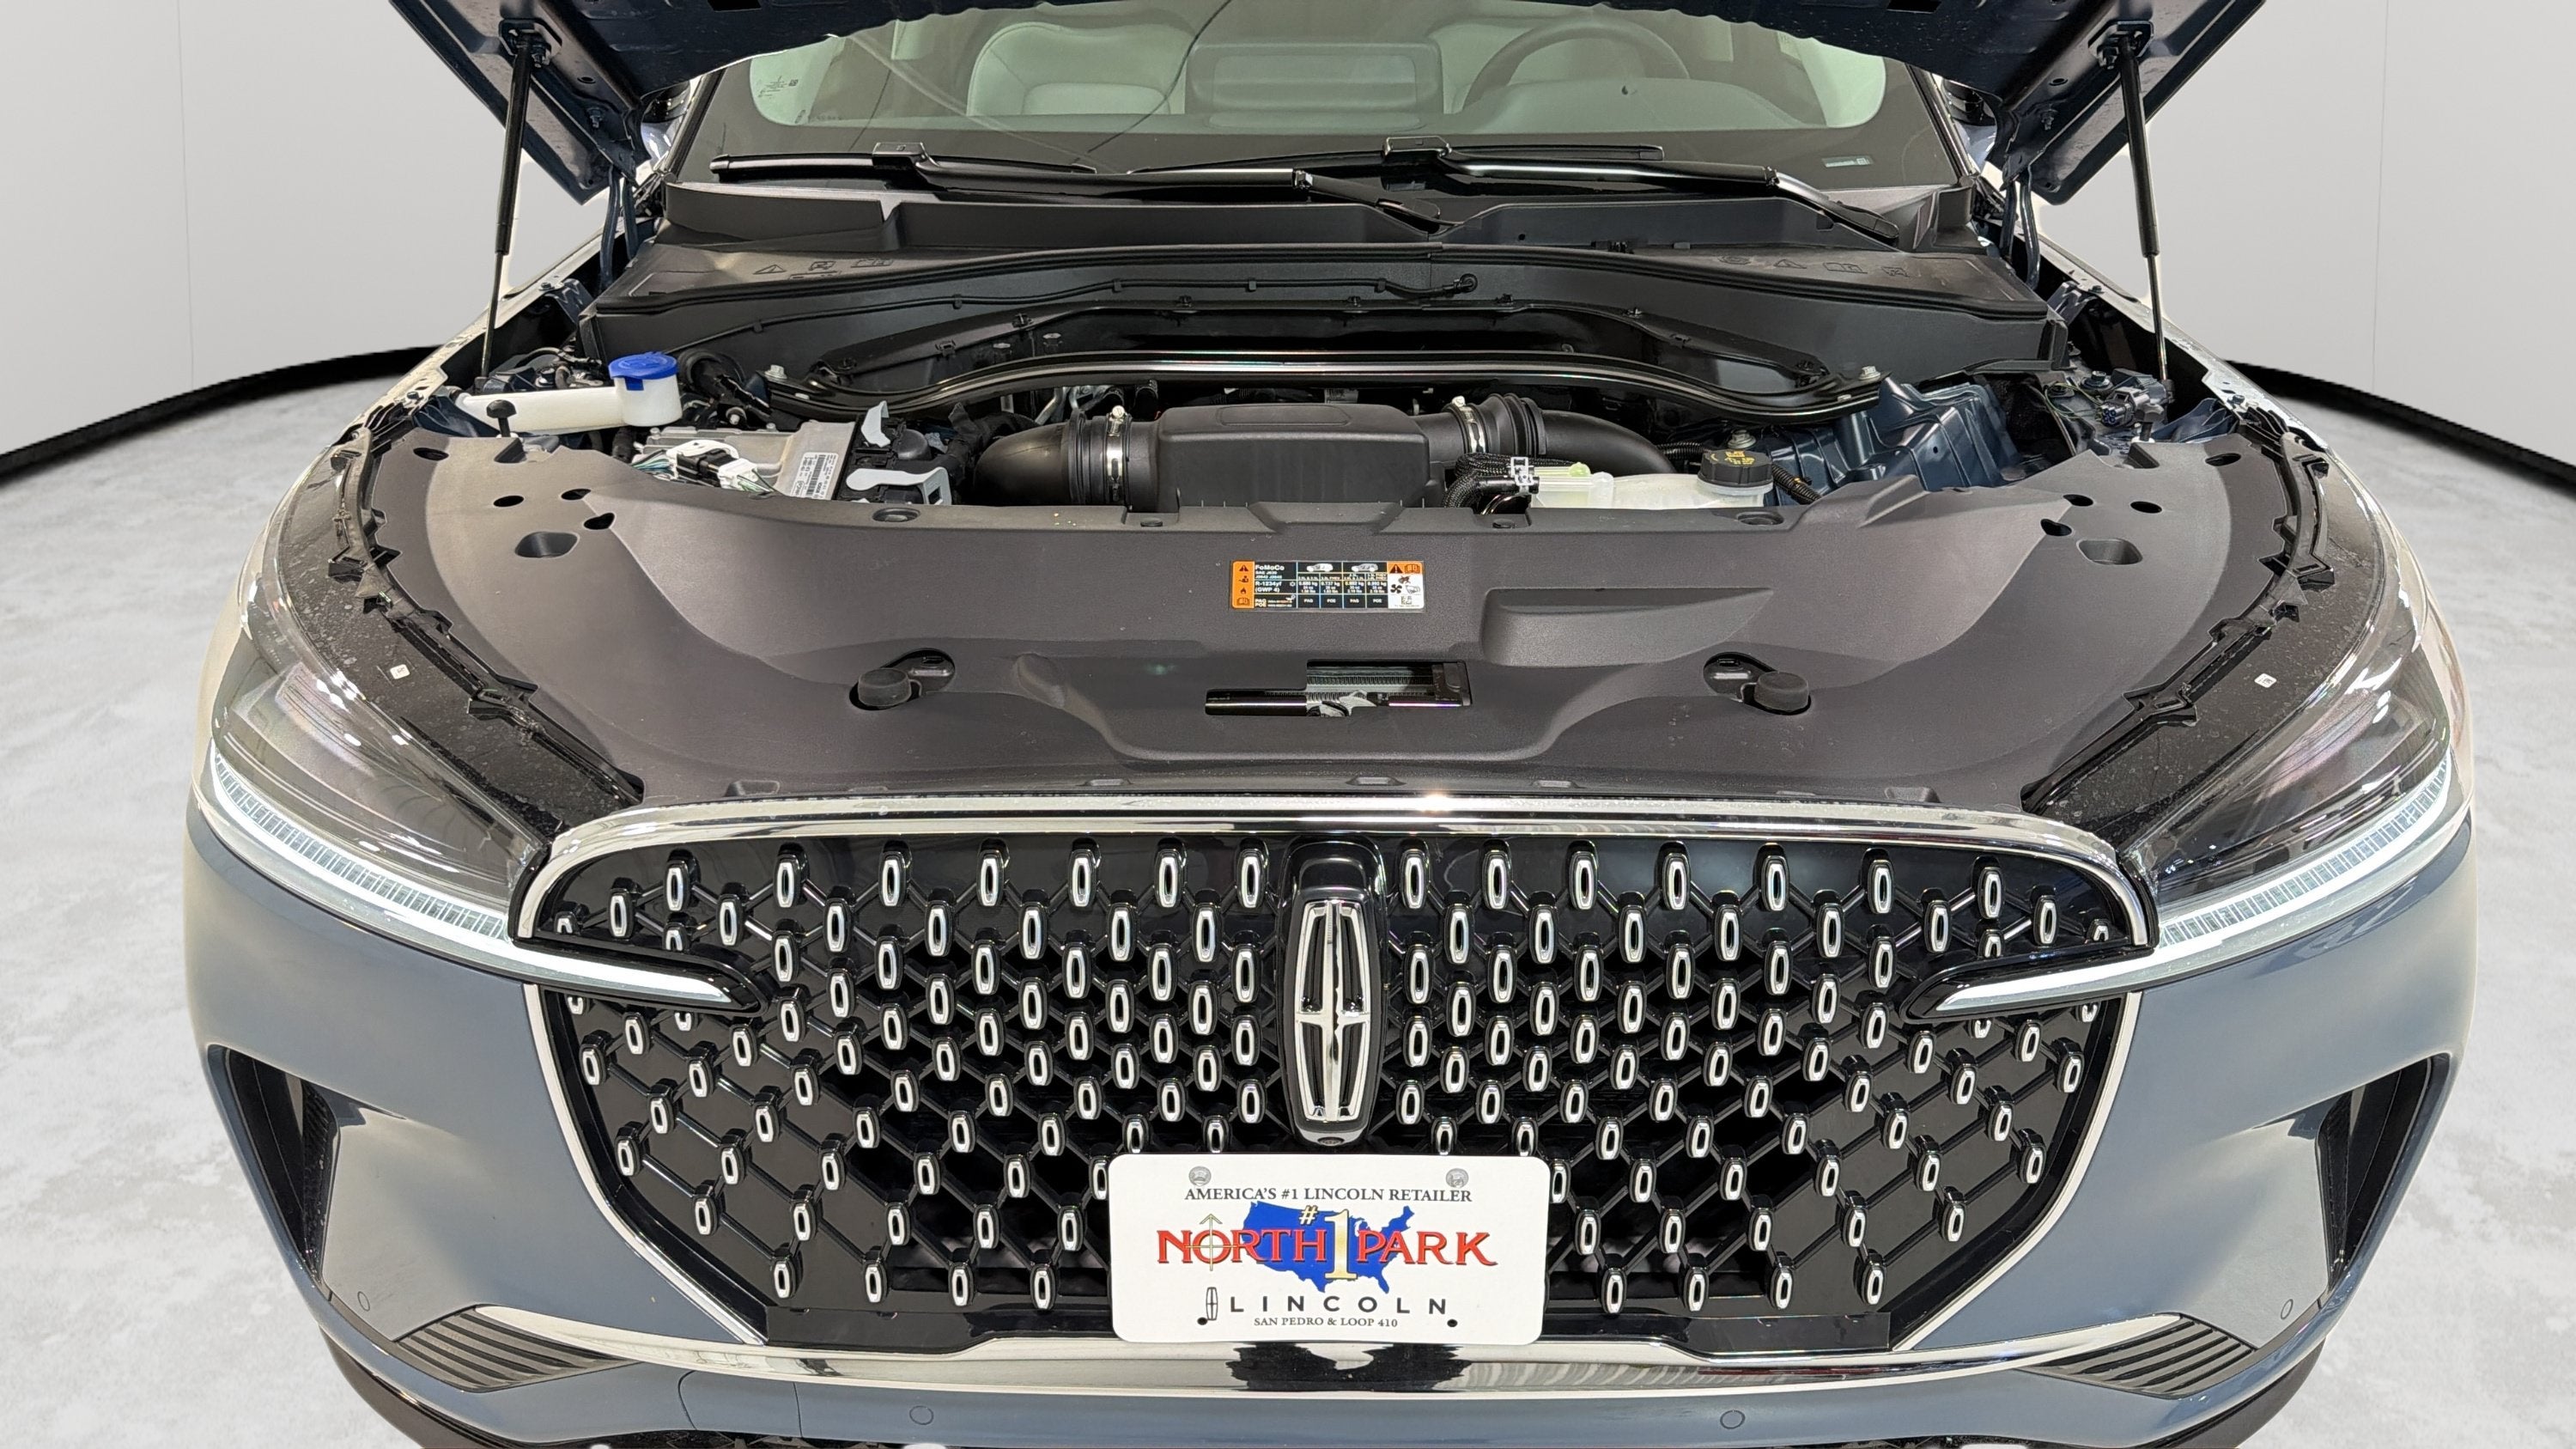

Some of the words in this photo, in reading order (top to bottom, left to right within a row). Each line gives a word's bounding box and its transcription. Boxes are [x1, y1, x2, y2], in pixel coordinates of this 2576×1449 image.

[1184, 1187, 1277, 1200] AMERICA'S
[1281, 1189, 1299, 1200] #1
[1303, 1188, 1384, 1200] LINCOLN
[1388, 1189, 1473, 1202] RETAILER
[1157, 1228, 1327, 1264] NORTH
[1356, 1230, 1499, 1267] PARK
[1230, 1295, 1447, 1315] LINCOLN
[1254, 1317, 1279, 1326] SAN
[1281, 1317, 1324, 1326] PEDRO
[1327, 1318, 1338, 1326] &
[1340, 1318, 1375, 1327] LOOP
[1377, 1318, 1398, 1328] 410
